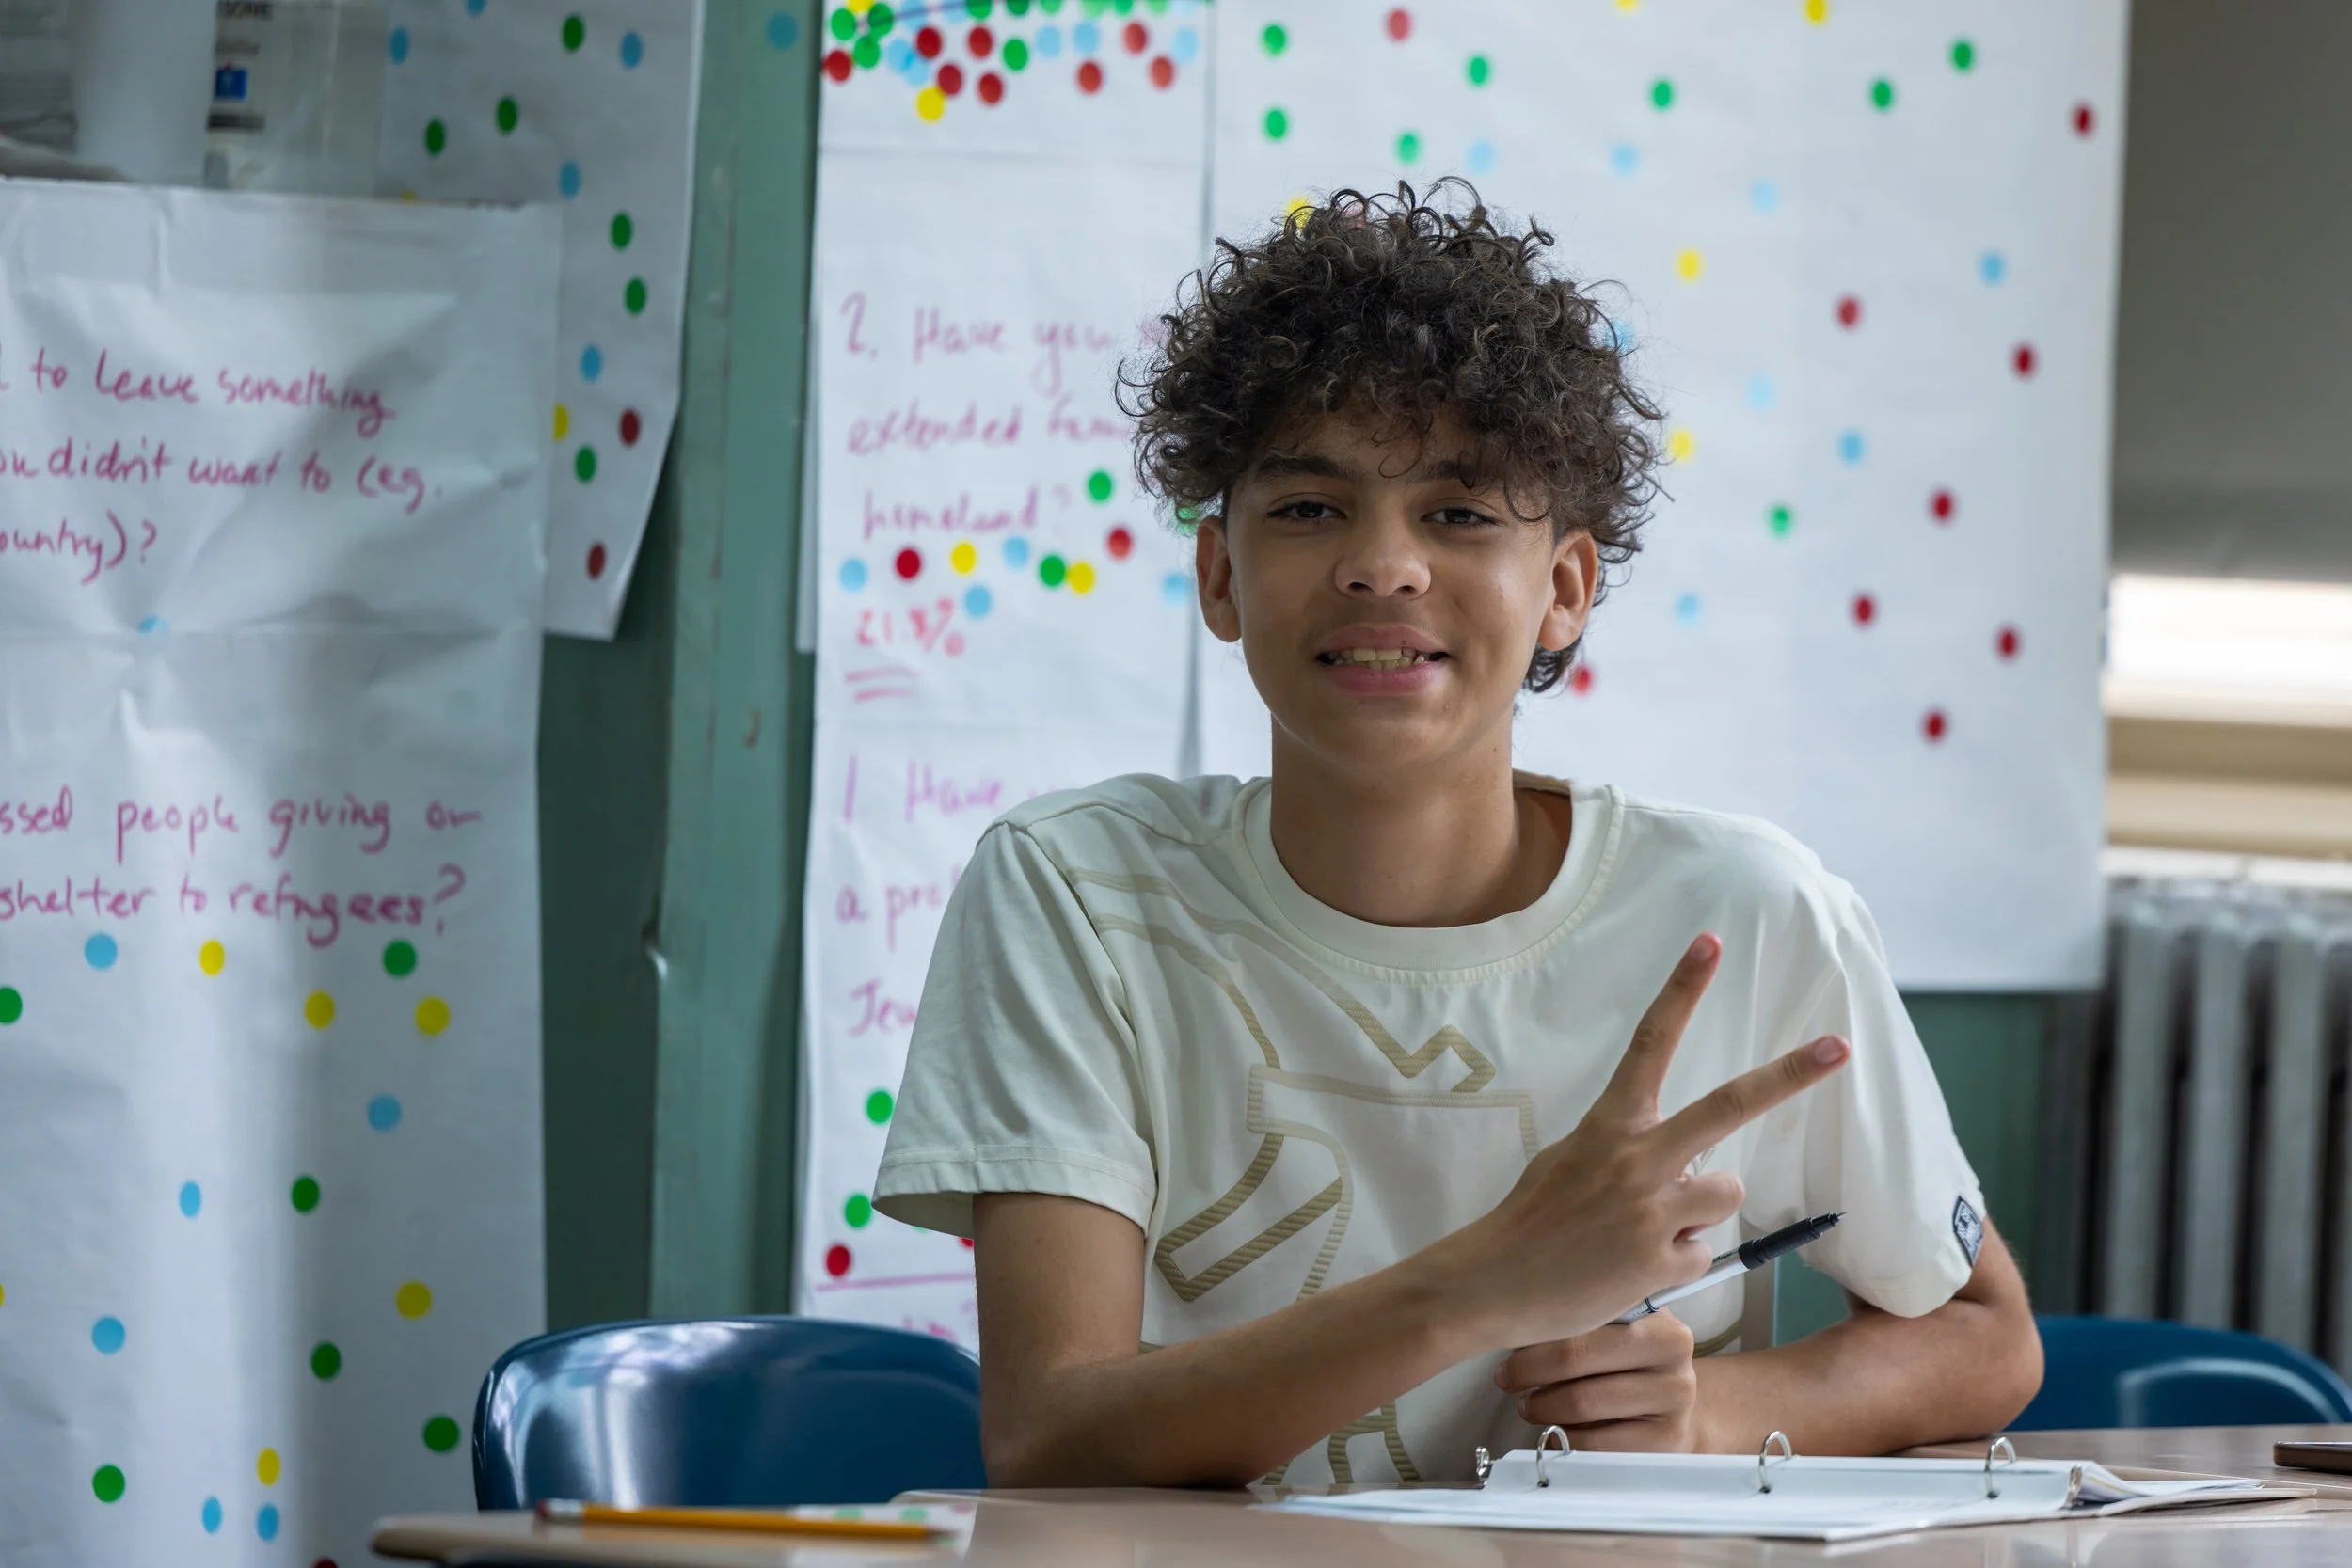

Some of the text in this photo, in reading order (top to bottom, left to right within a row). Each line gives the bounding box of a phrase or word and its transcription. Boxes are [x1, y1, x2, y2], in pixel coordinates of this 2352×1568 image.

[911, 304, 1006, 365] Have
[31, 345, 67, 393] to
[217, 366, 396, 442] something
[846, 392, 1135, 457] extended fam
[48, 435, 172, 484] didn't
[189, 446, 281, 487] want
[299, 448, 331, 494] to
[904, 757, 1003, 823] Have
[117, 793, 240, 867] people
[269, 791, 391, 860] giving
[0, 862, 466, 948] shelter to refugees?
[835, 882, 871, 926] a
